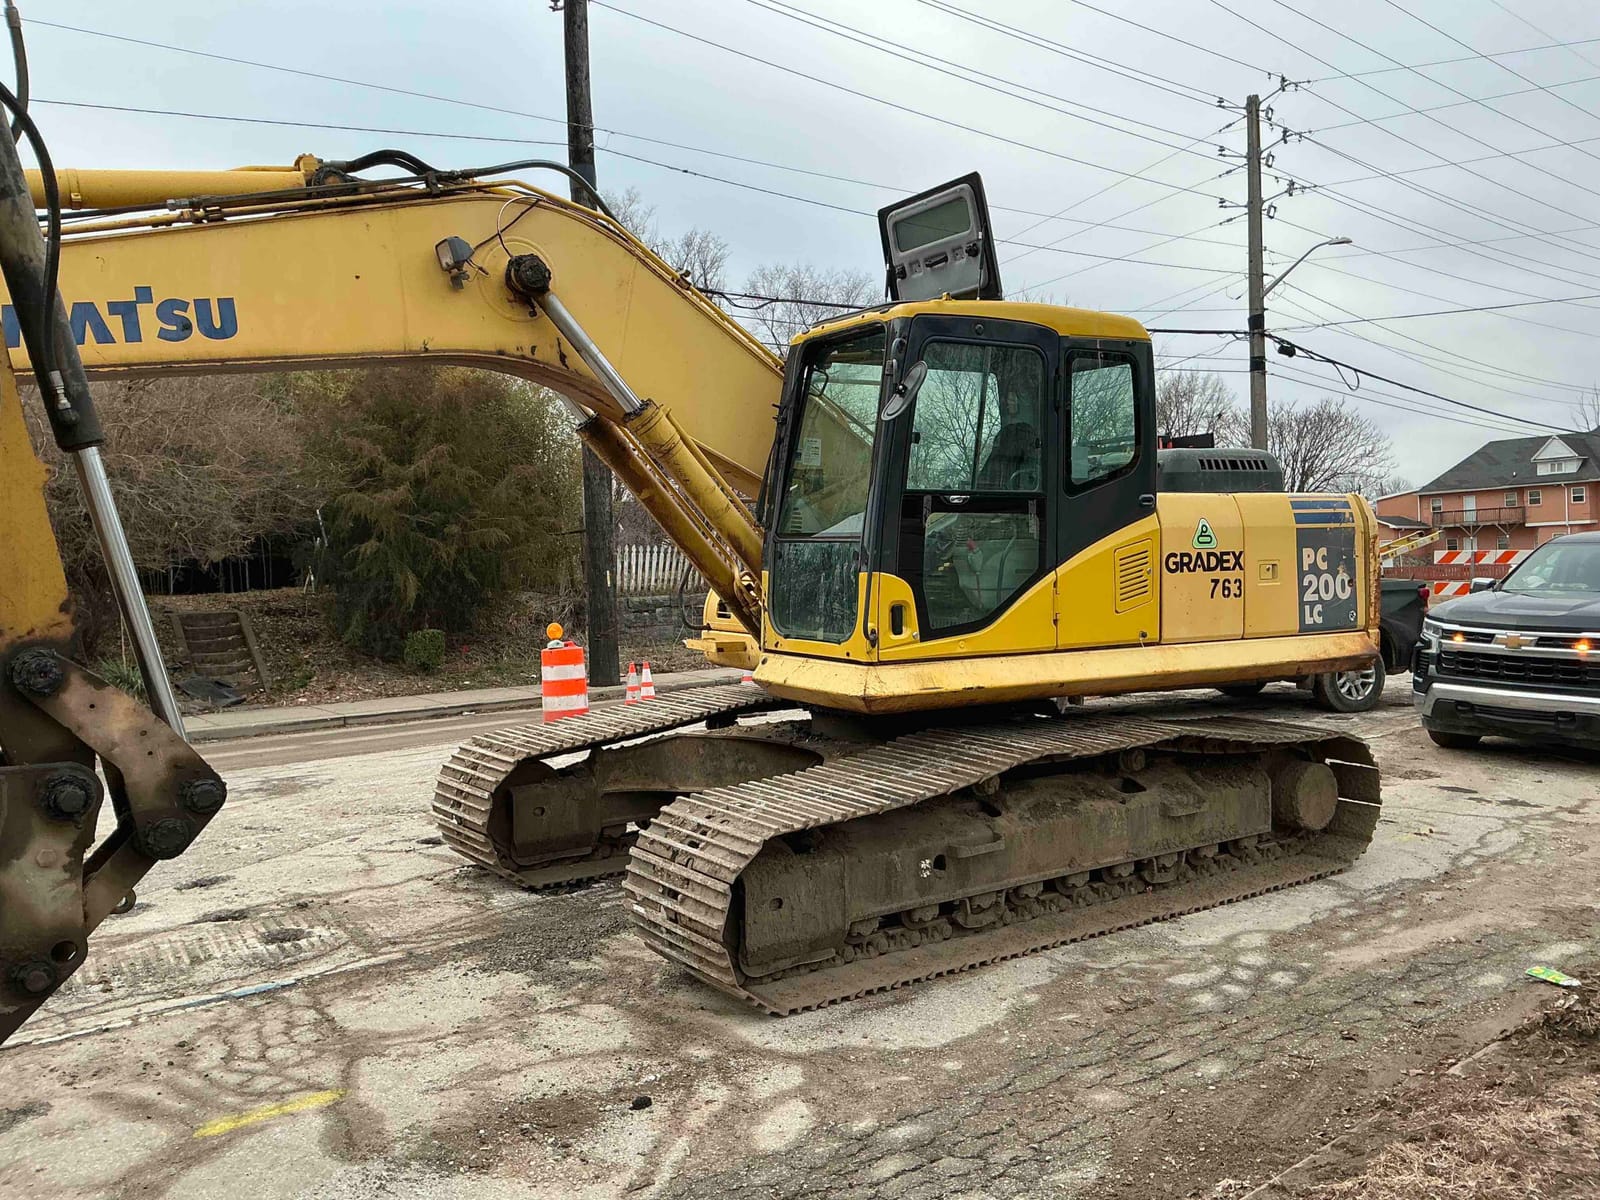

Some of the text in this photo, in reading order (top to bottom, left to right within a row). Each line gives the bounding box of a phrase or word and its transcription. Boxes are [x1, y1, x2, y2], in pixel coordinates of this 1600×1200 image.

[1164, 550, 1244, 574] GRADEX
[1302, 547, 1328, 571] PC
[1210, 578, 1242, 599] 763
[1303, 573, 1351, 601] 200
[1304, 604, 1323, 625] LC
